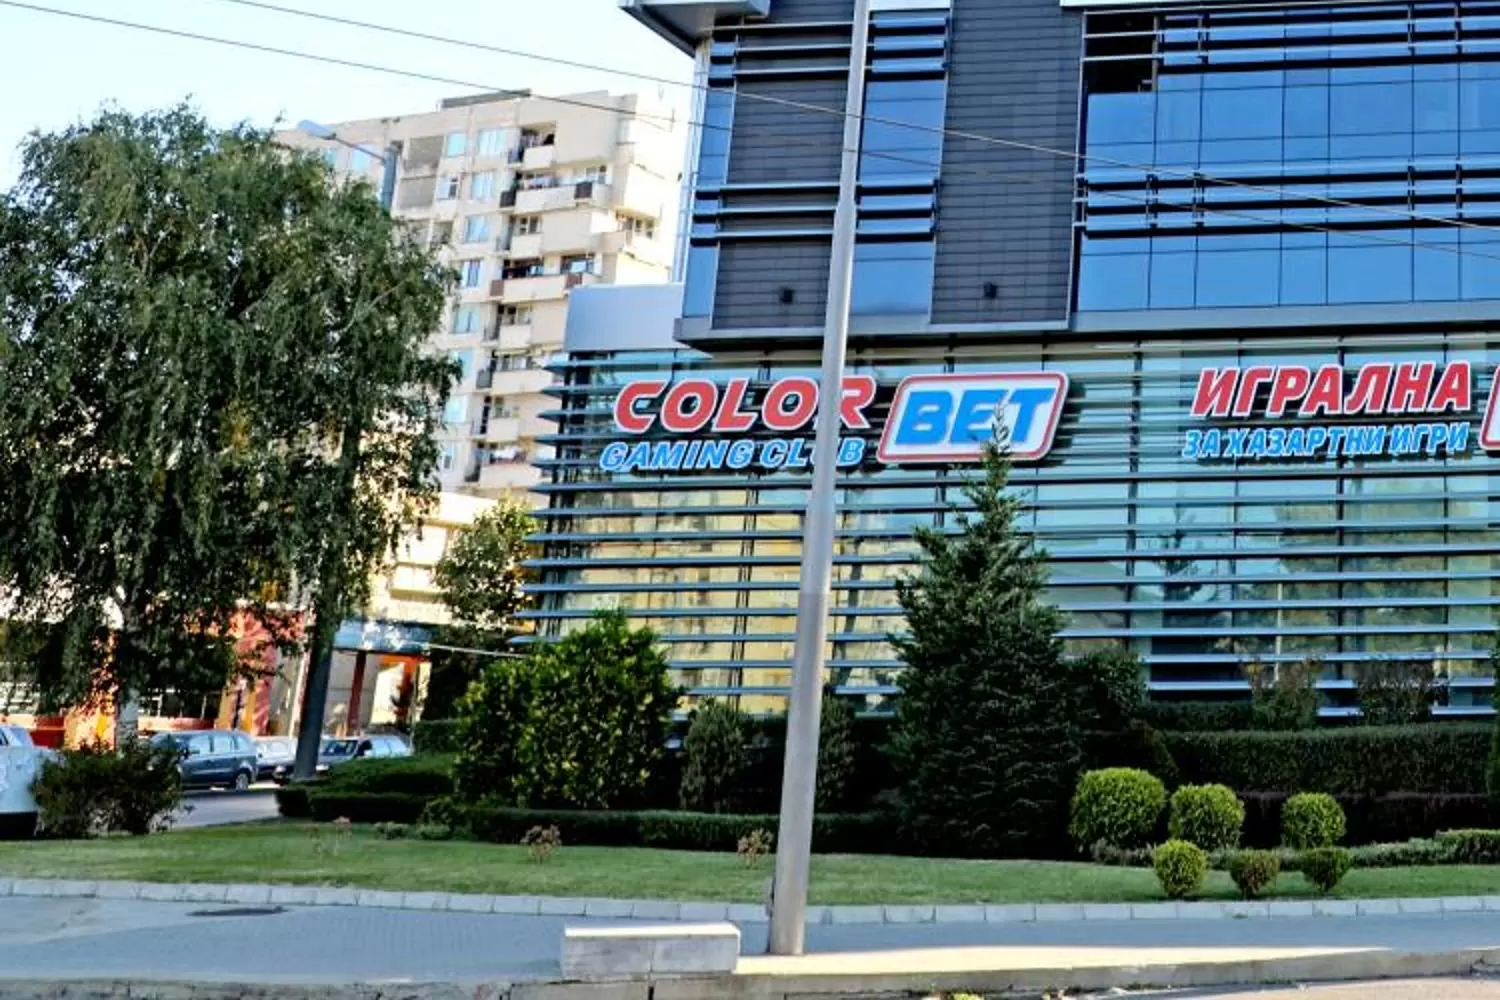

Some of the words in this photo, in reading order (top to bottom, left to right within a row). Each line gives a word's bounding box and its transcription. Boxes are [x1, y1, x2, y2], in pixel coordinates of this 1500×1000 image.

[613, 376, 877, 433] COLOR
[896, 387, 1057, 446] BET
[1190, 361, 1471, 417] ИГРАЛНА
[600, 439, 756, 471] GAMING
[759, 437, 864, 468] CLB
[1182, 429, 1221, 457] ЗА
[1223, 424, 1387, 457] ХАЗАРТНИ
[1388, 422, 1470, 454] ИГРИ
